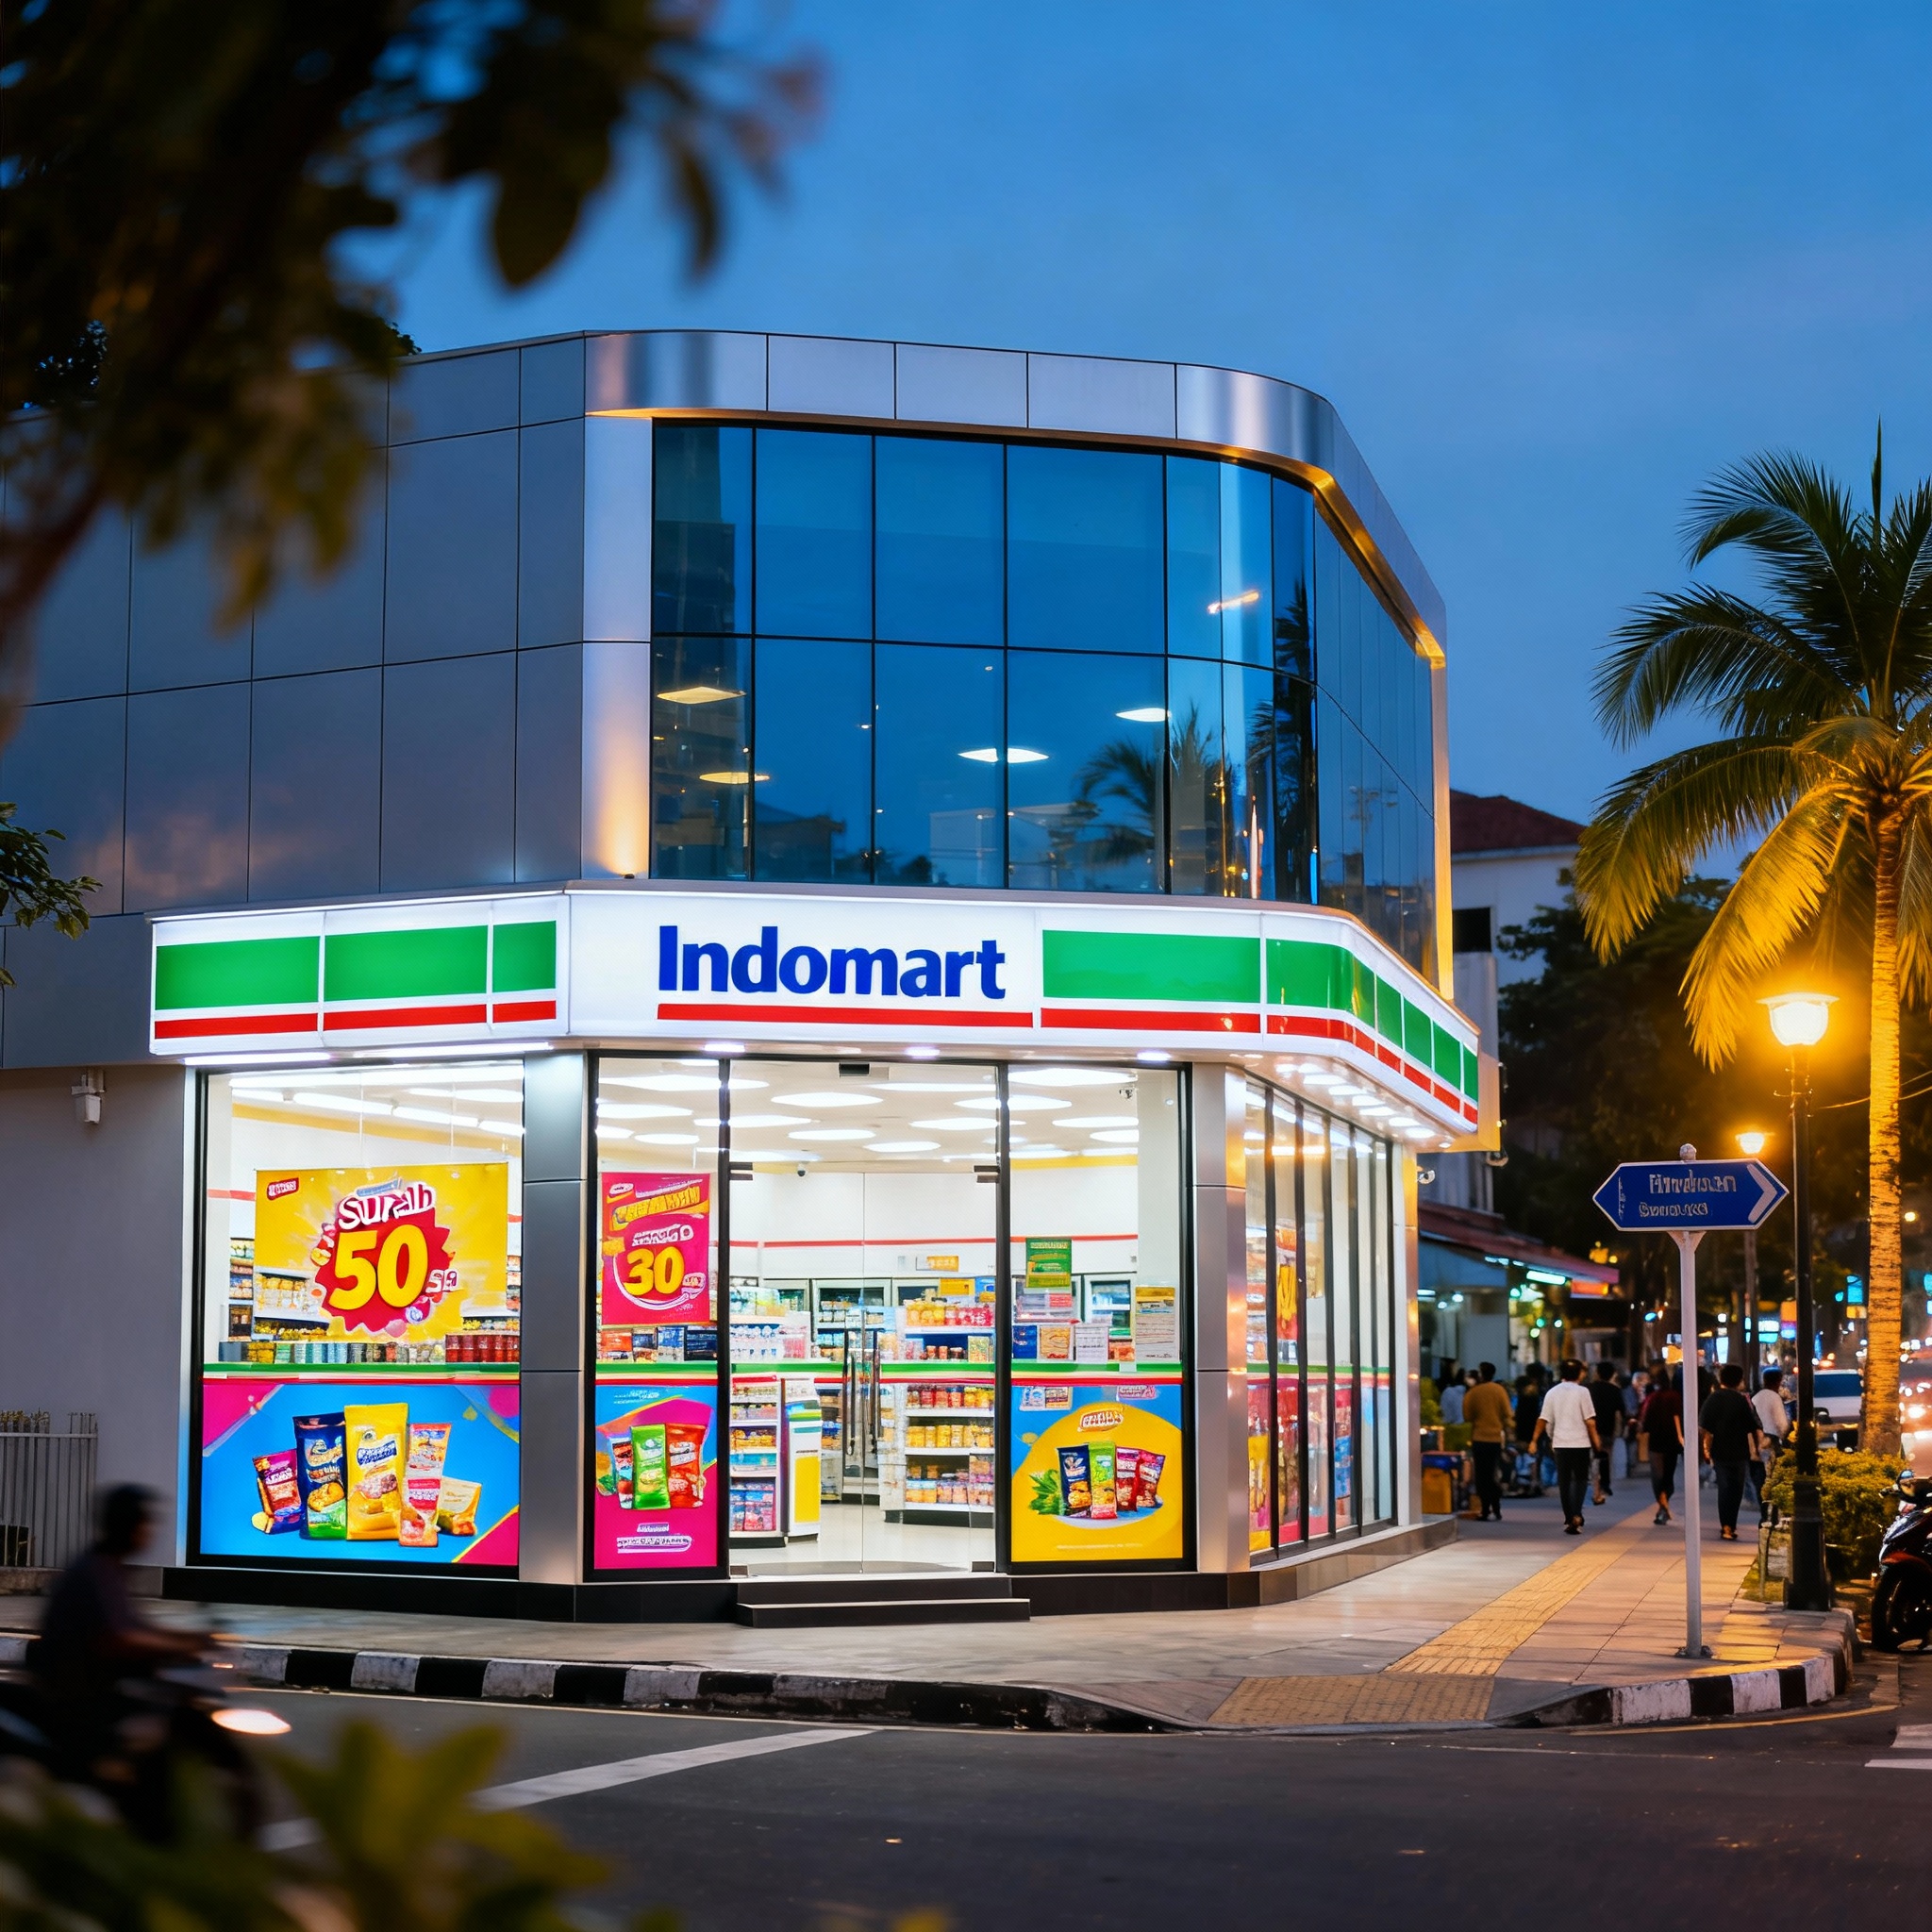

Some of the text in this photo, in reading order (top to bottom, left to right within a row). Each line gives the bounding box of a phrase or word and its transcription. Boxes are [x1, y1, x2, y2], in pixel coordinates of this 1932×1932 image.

[659, 925, 1006, 999] Indomart
[328, 1224, 428, 1310] 50
[623, 1246, 685, 1296] 30
